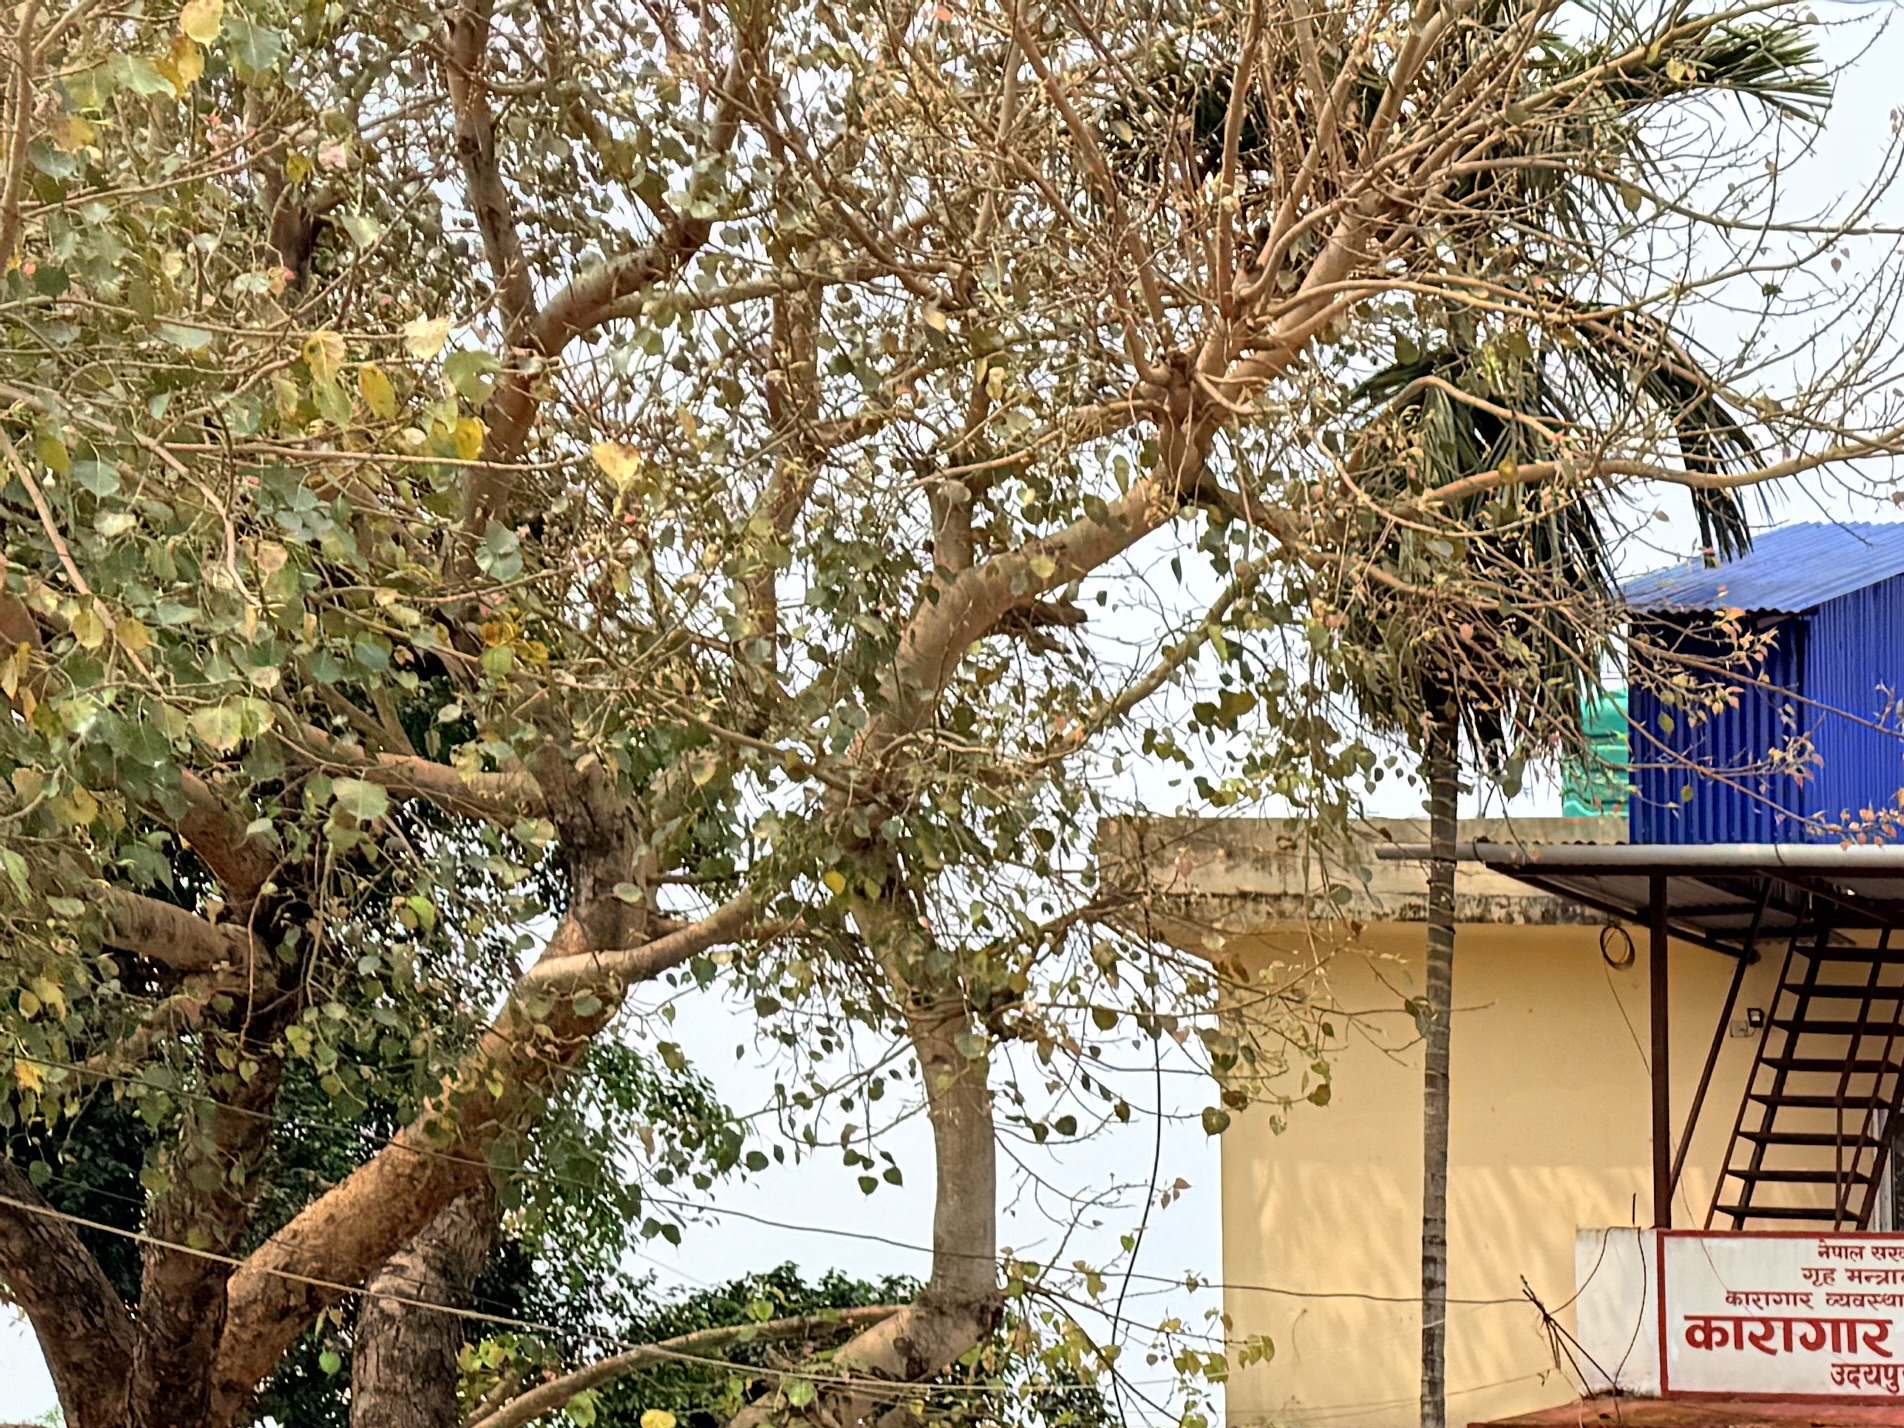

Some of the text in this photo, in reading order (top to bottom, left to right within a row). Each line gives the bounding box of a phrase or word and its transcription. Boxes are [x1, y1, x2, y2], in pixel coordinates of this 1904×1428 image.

[1817, 1239, 1865, 1260] नेपाल
[1801, 1267, 1836, 1287] गृह
[1725, 1290, 1814, 1310] कारागार
[1684, 1315, 1893, 1358] कारागार
